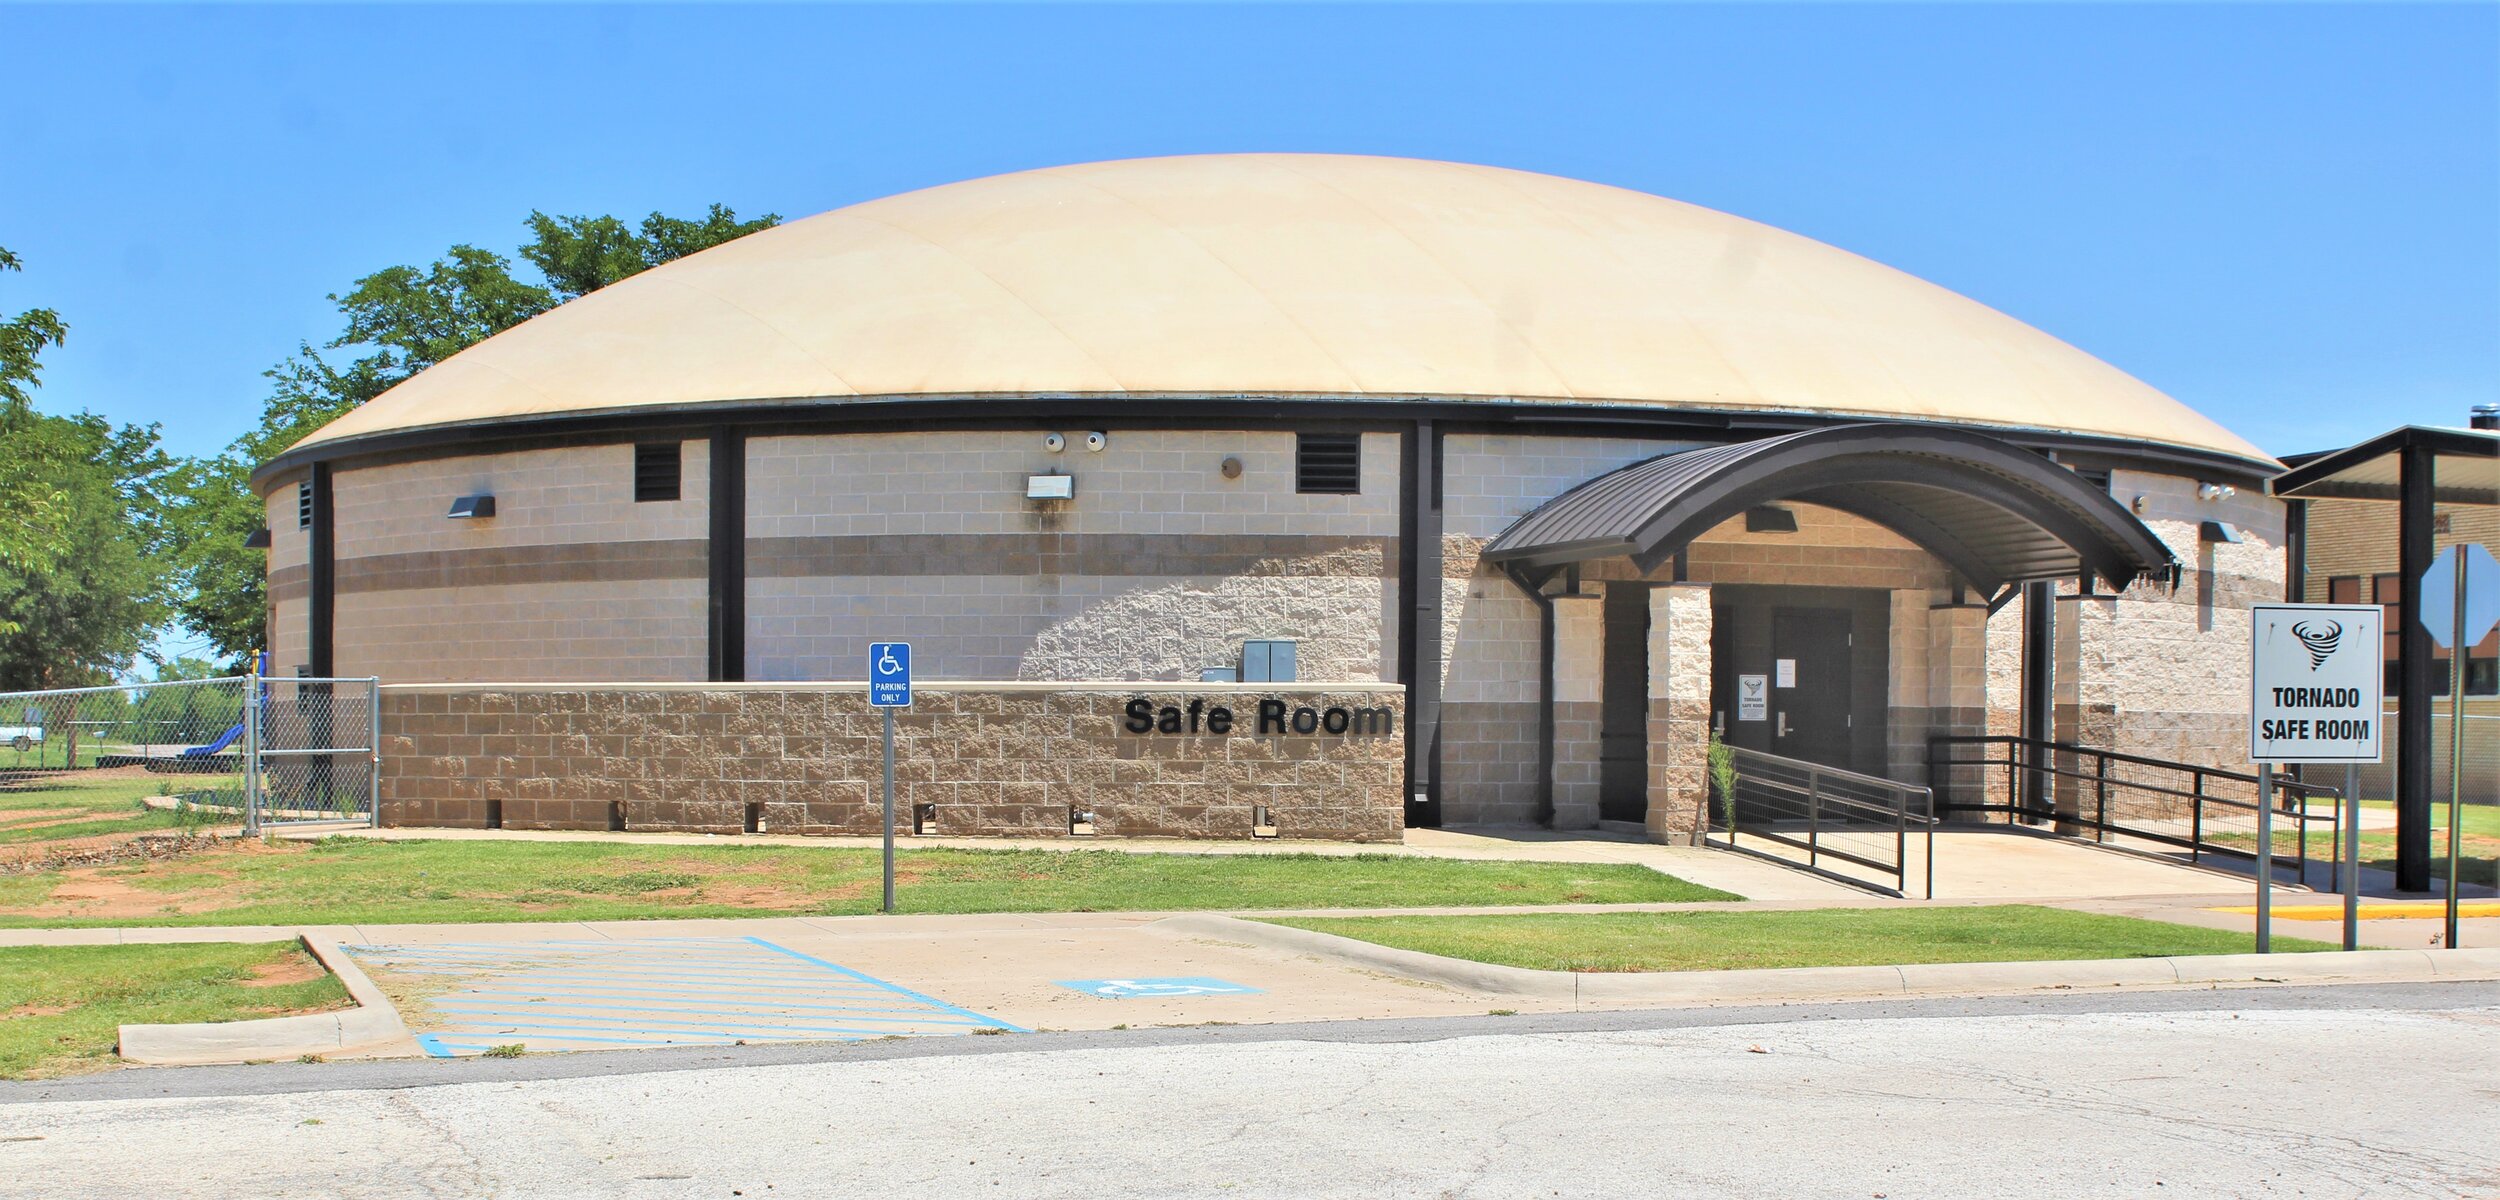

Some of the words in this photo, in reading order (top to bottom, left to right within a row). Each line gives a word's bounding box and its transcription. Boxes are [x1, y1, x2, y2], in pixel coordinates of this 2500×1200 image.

[875, 683, 907, 691] PARKING
[881, 693, 900, 702] ONLY
[2272, 687, 2360, 708] TORNADO
[1125, 699, 1233, 734] Safe
[1259, 699, 1393, 734] Room
[2262, 719, 2309, 740] SAFE
[2315, 719, 2369, 740] ROOM
